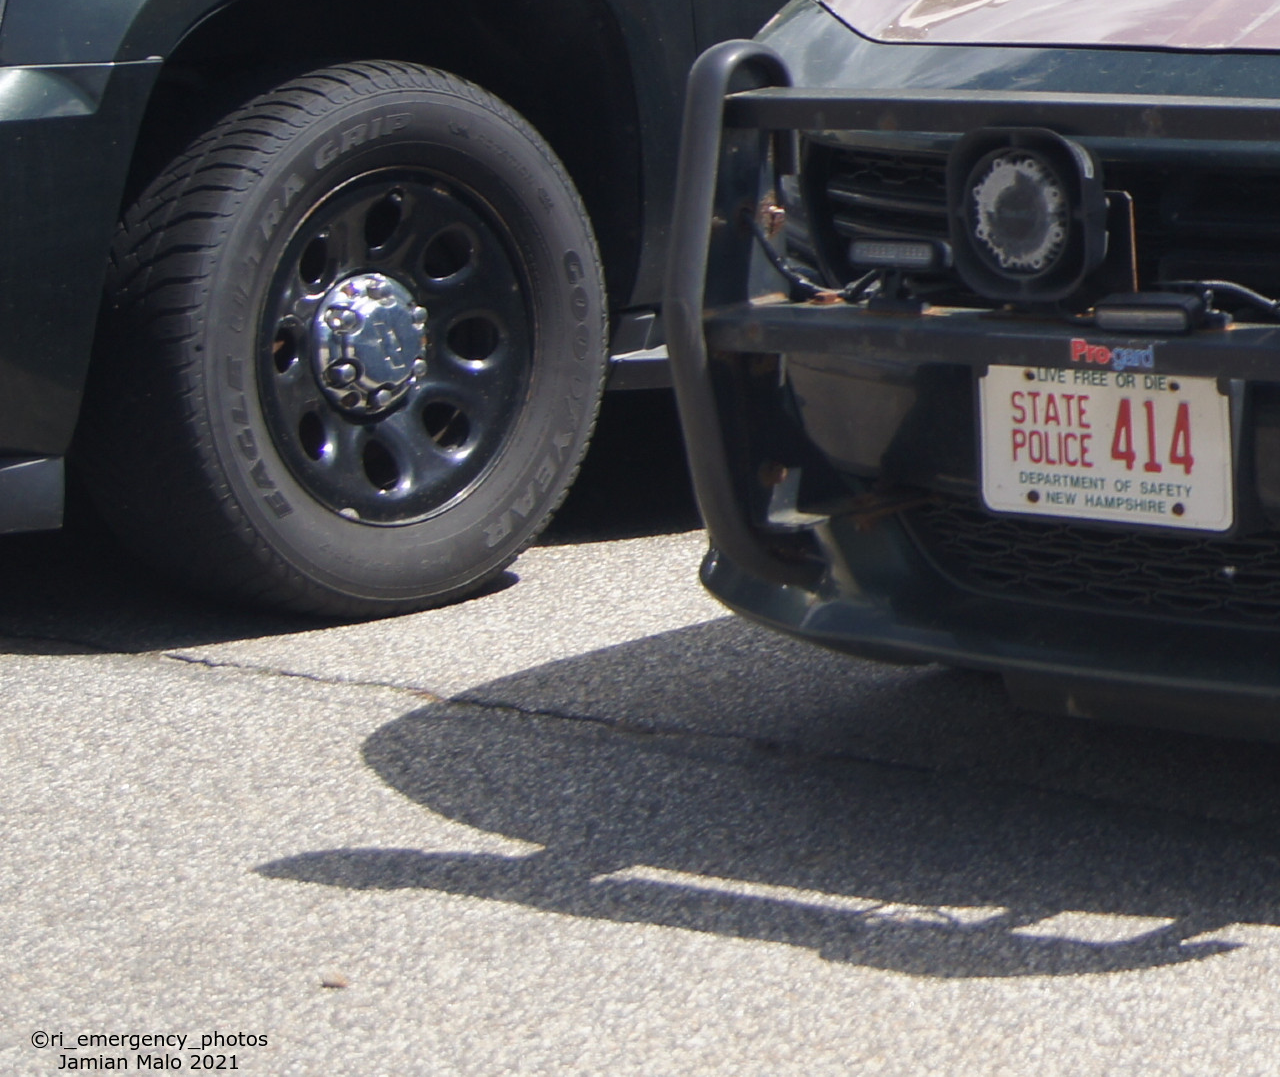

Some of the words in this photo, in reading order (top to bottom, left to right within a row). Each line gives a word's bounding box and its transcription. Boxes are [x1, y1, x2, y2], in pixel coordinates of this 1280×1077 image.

[312, 112, 415, 170] GRIP
[1037, 367, 1065, 383] LIVE
[1073, 370, 1109, 387] FREE
[1115, 372, 1136, 389] OR
[1144, 375, 1168, 391] DIE
[229, 353, 294, 519] EAGLE
[1010, 391, 1091, 429] STATE
[1111, 398, 1195, 475] 414
[1011, 429, 1094, 468] POLICE
[1019, 471, 1106, 490] DEPARTMENT
[1114, 479, 1132, 493] OF
[1140, 481, 1193, 499] SAFETY
[1046, 492, 1076, 505] NEW
[1084, 496, 1167, 514] HAMPSHIRE
